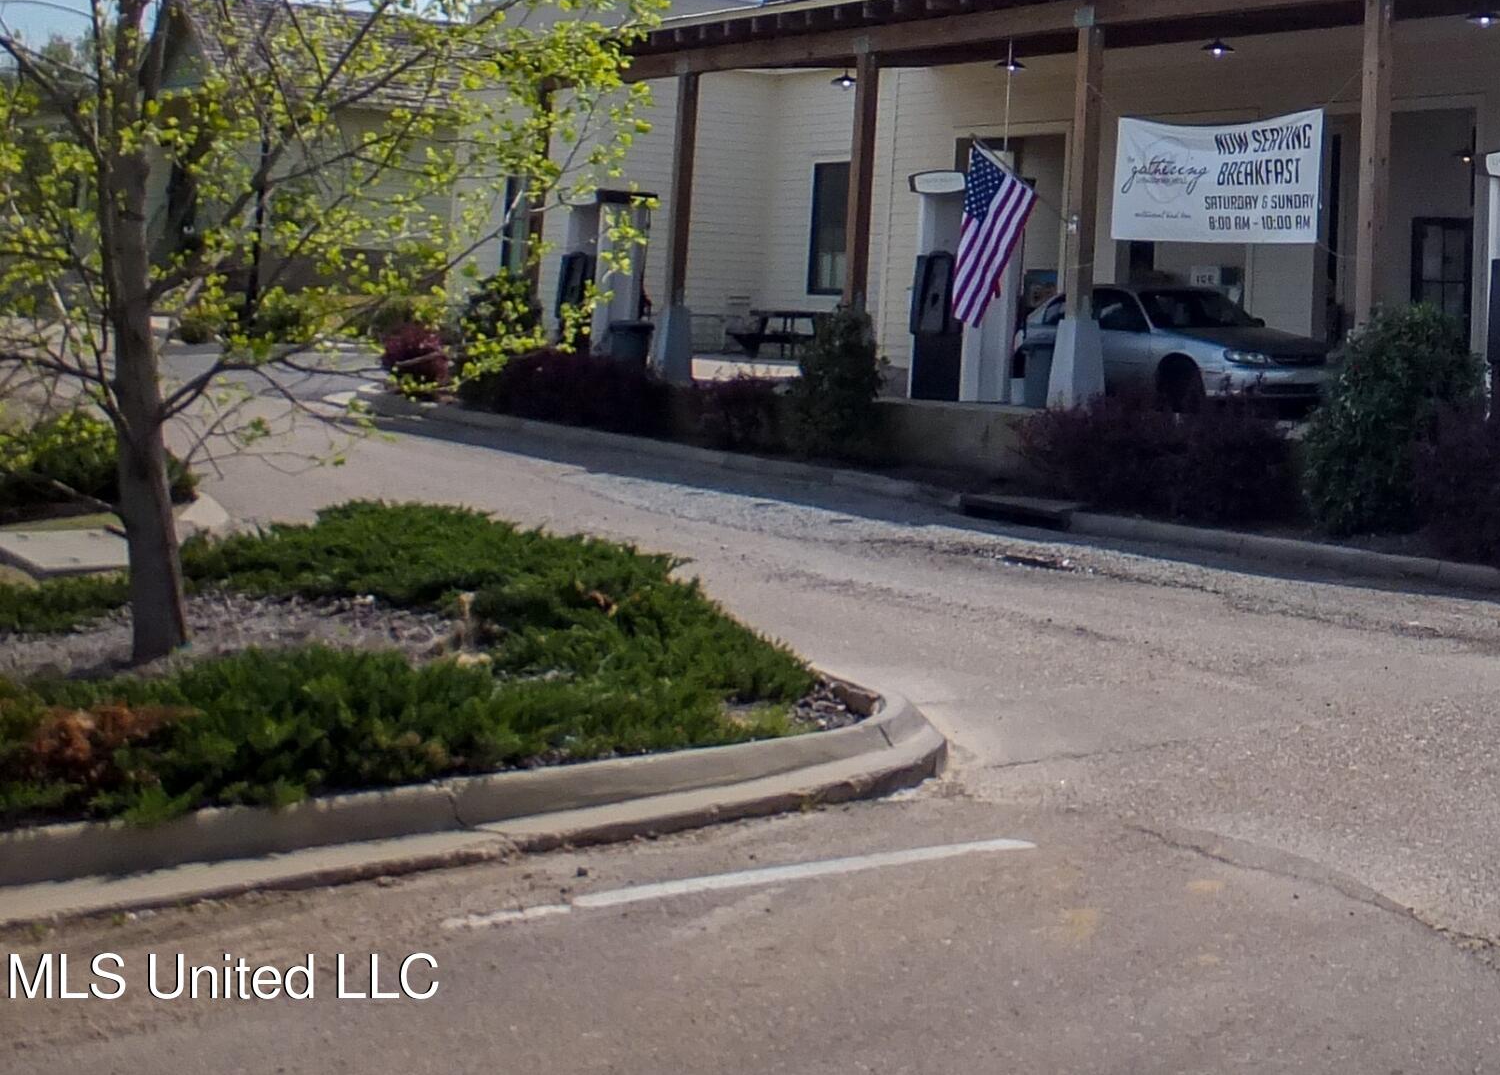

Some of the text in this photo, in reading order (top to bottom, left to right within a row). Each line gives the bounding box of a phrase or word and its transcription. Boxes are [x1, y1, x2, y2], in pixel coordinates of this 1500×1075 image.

[1214, 124, 1312, 155] NOW SERVING
[1217, 157, 1301, 187] BREAKFAST
[1204, 195, 1259, 210] SATURDAY
[1271, 194, 1315, 209] SUNDAY
[1209, 216, 1231, 231] 8:00
[1235, 216, 1250, 230] AM
[1261, 215, 1292, 230] 10:00
[1295, 215, 1311, 229] AM
